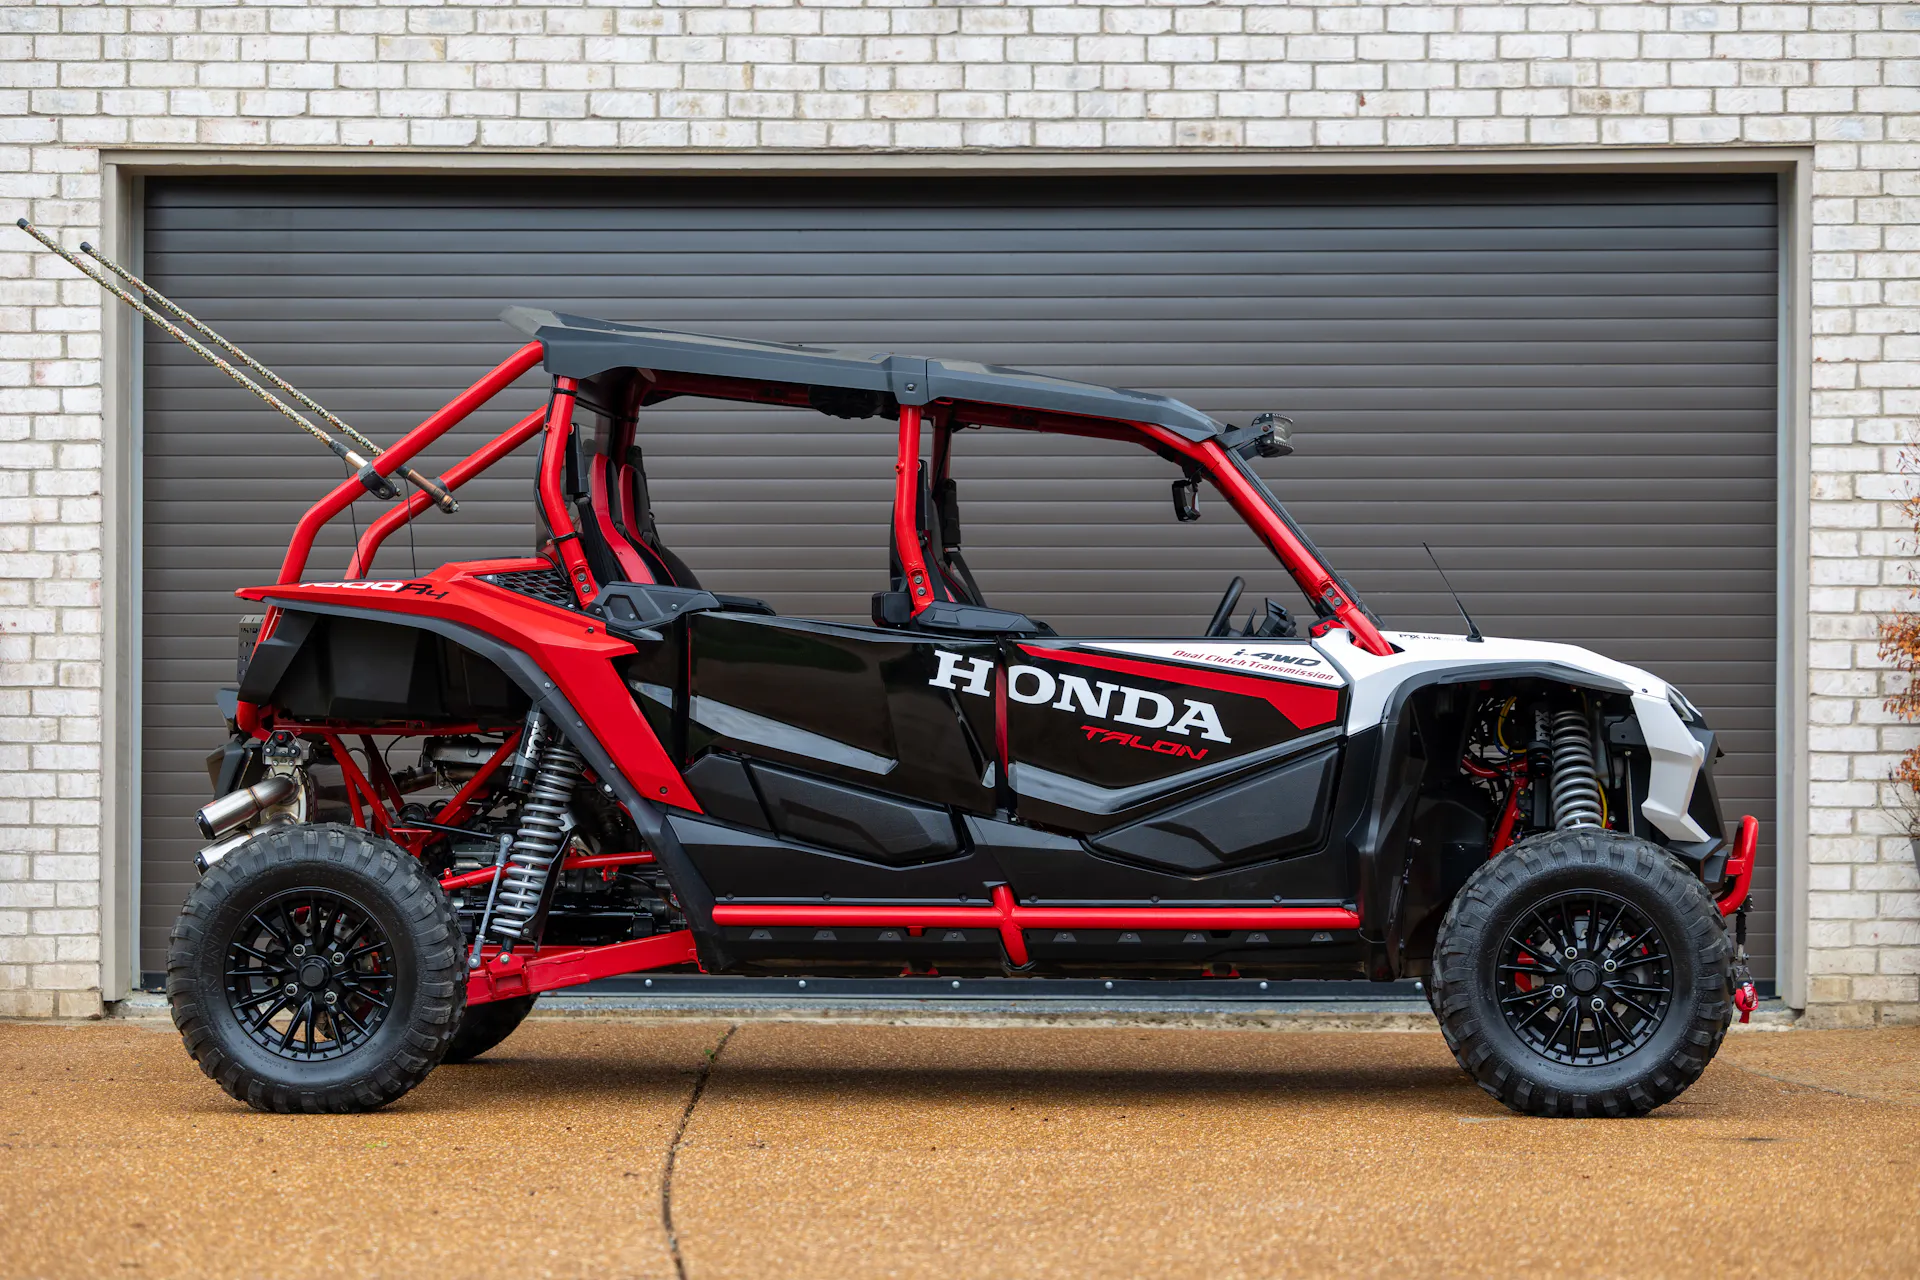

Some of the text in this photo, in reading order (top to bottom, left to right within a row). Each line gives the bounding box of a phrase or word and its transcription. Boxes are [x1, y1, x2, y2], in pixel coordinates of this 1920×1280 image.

[1172, 650, 1335, 681] Dual Clutch Transmission
[1233, 649, 1322, 667] i-4WD
[928, 650, 1232, 744] HONDA
[525, 720, 548, 760] FOX
[1080, 725, 1209, 761] TALON
